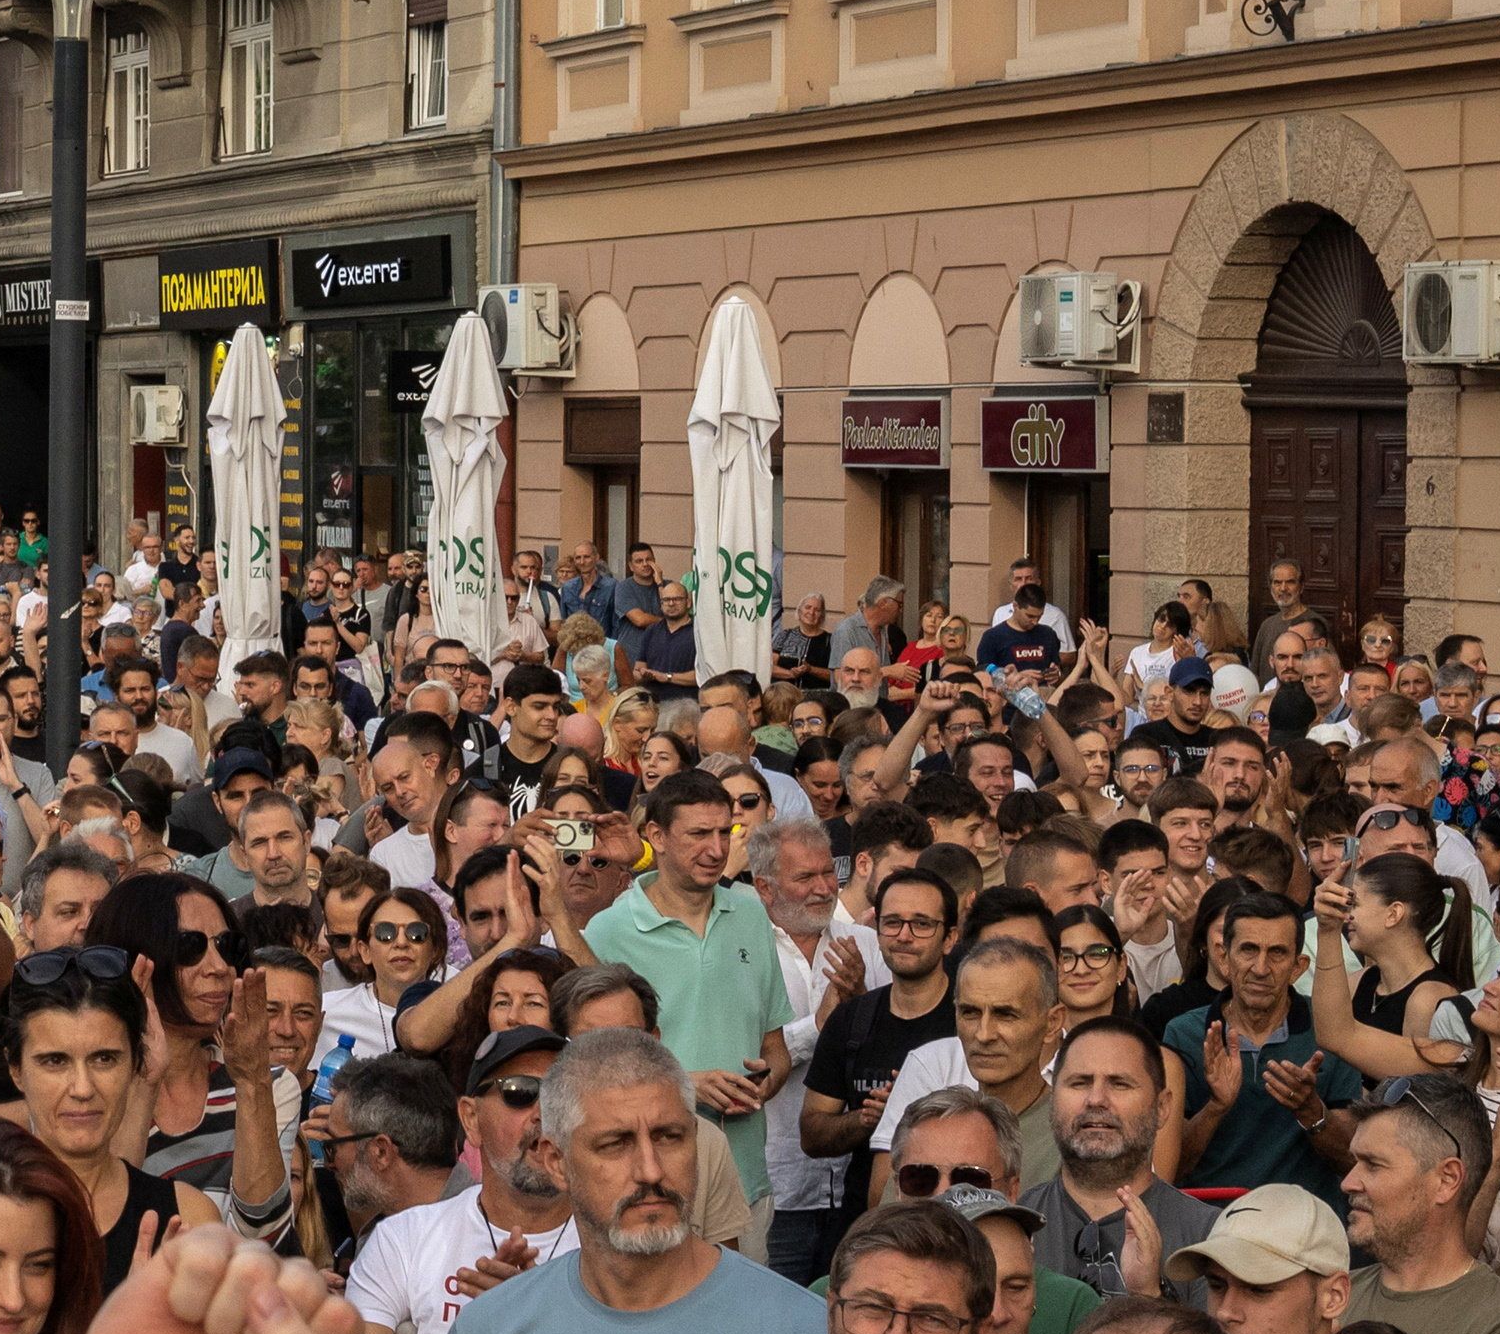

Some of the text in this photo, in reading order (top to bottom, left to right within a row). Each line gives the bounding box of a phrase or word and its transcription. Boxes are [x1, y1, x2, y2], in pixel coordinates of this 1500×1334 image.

[162, 266, 266, 313] ПОЗАМАНТЕРИЈА
[338, 262, 400, 286] exterra
[844, 416, 940, 451] Poslastičarnica
